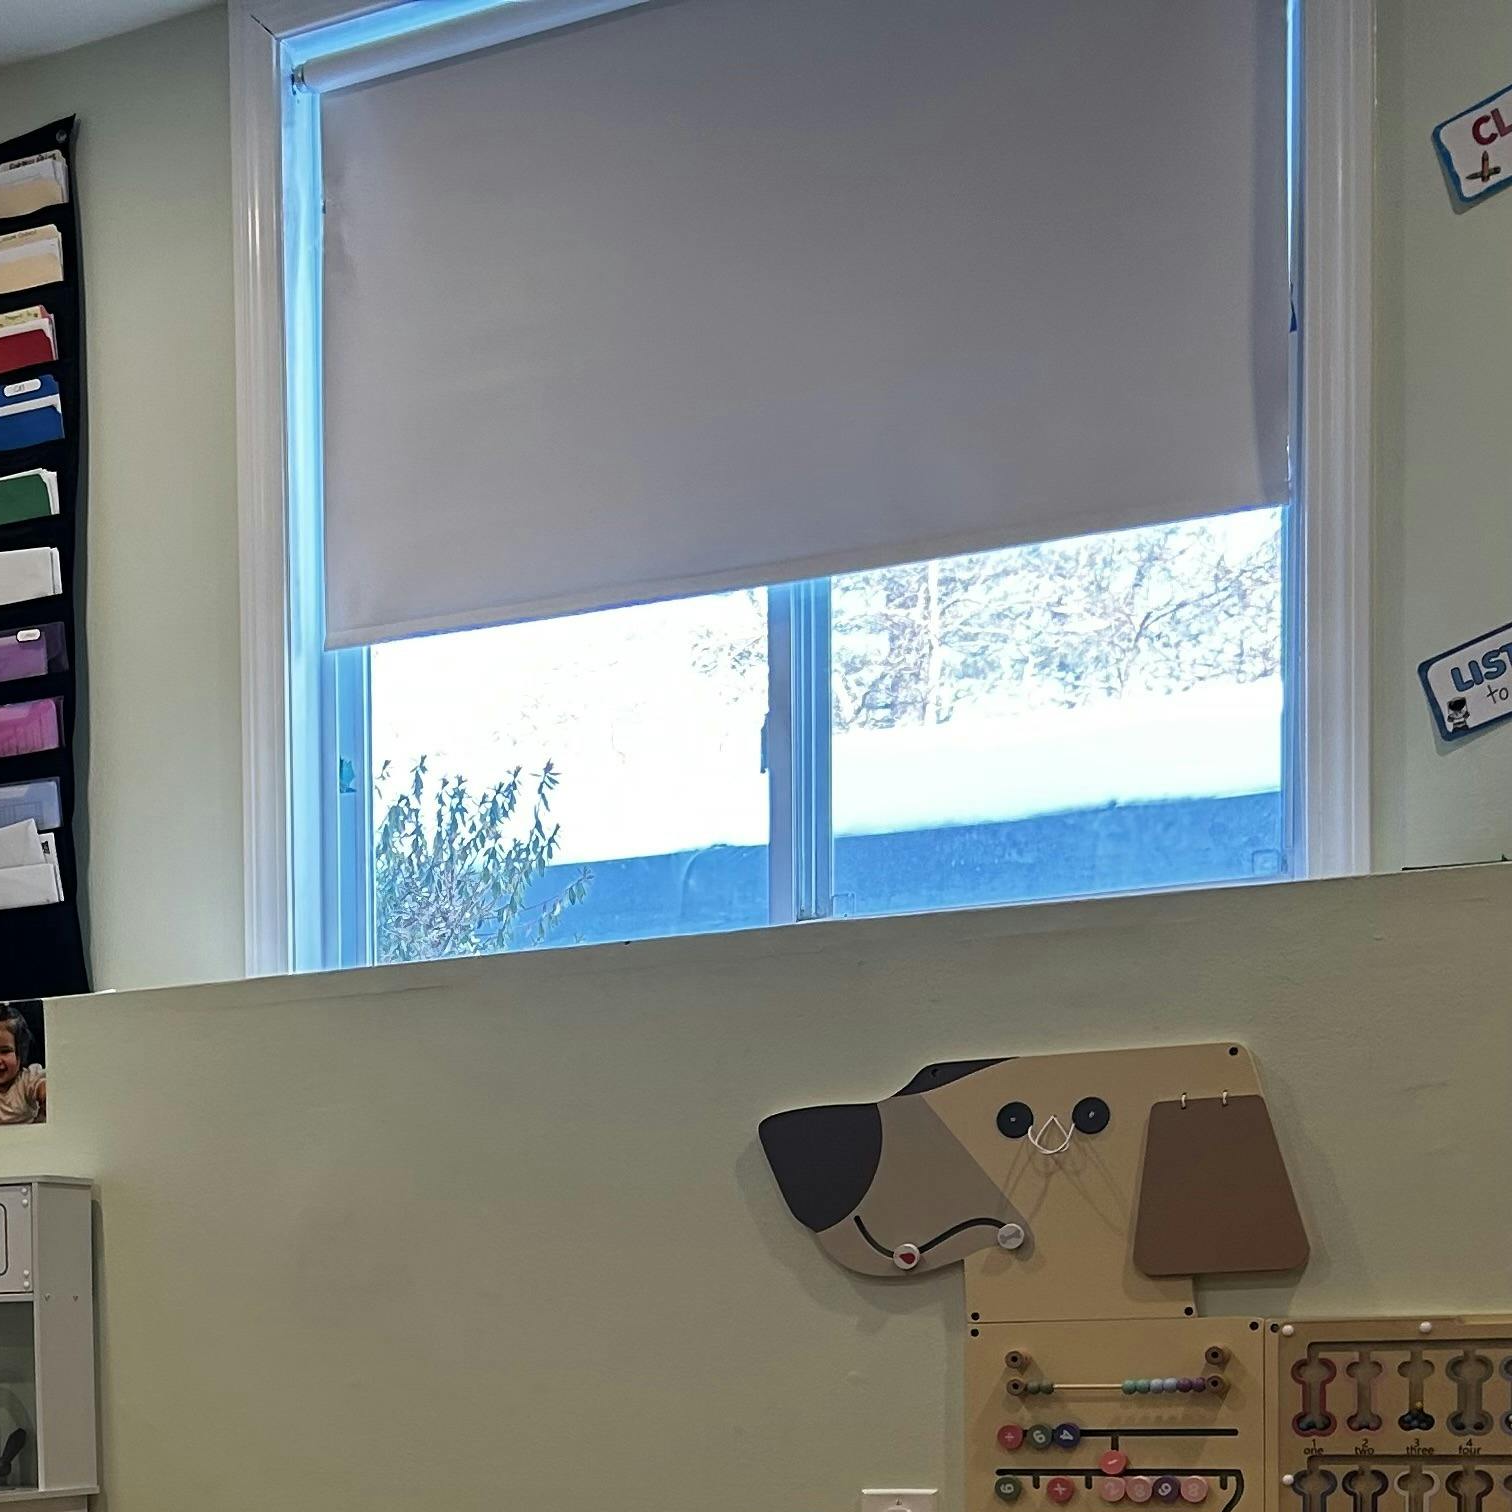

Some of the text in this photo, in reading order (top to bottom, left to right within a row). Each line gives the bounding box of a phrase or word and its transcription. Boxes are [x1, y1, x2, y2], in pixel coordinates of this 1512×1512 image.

[1361, 1438, 1369, 1447] 2
[1414, 1438, 1420, 1447] 3
[1466, 1438, 1473, 1447] 4
[1303, 1446, 1482, 1455] one two three four
